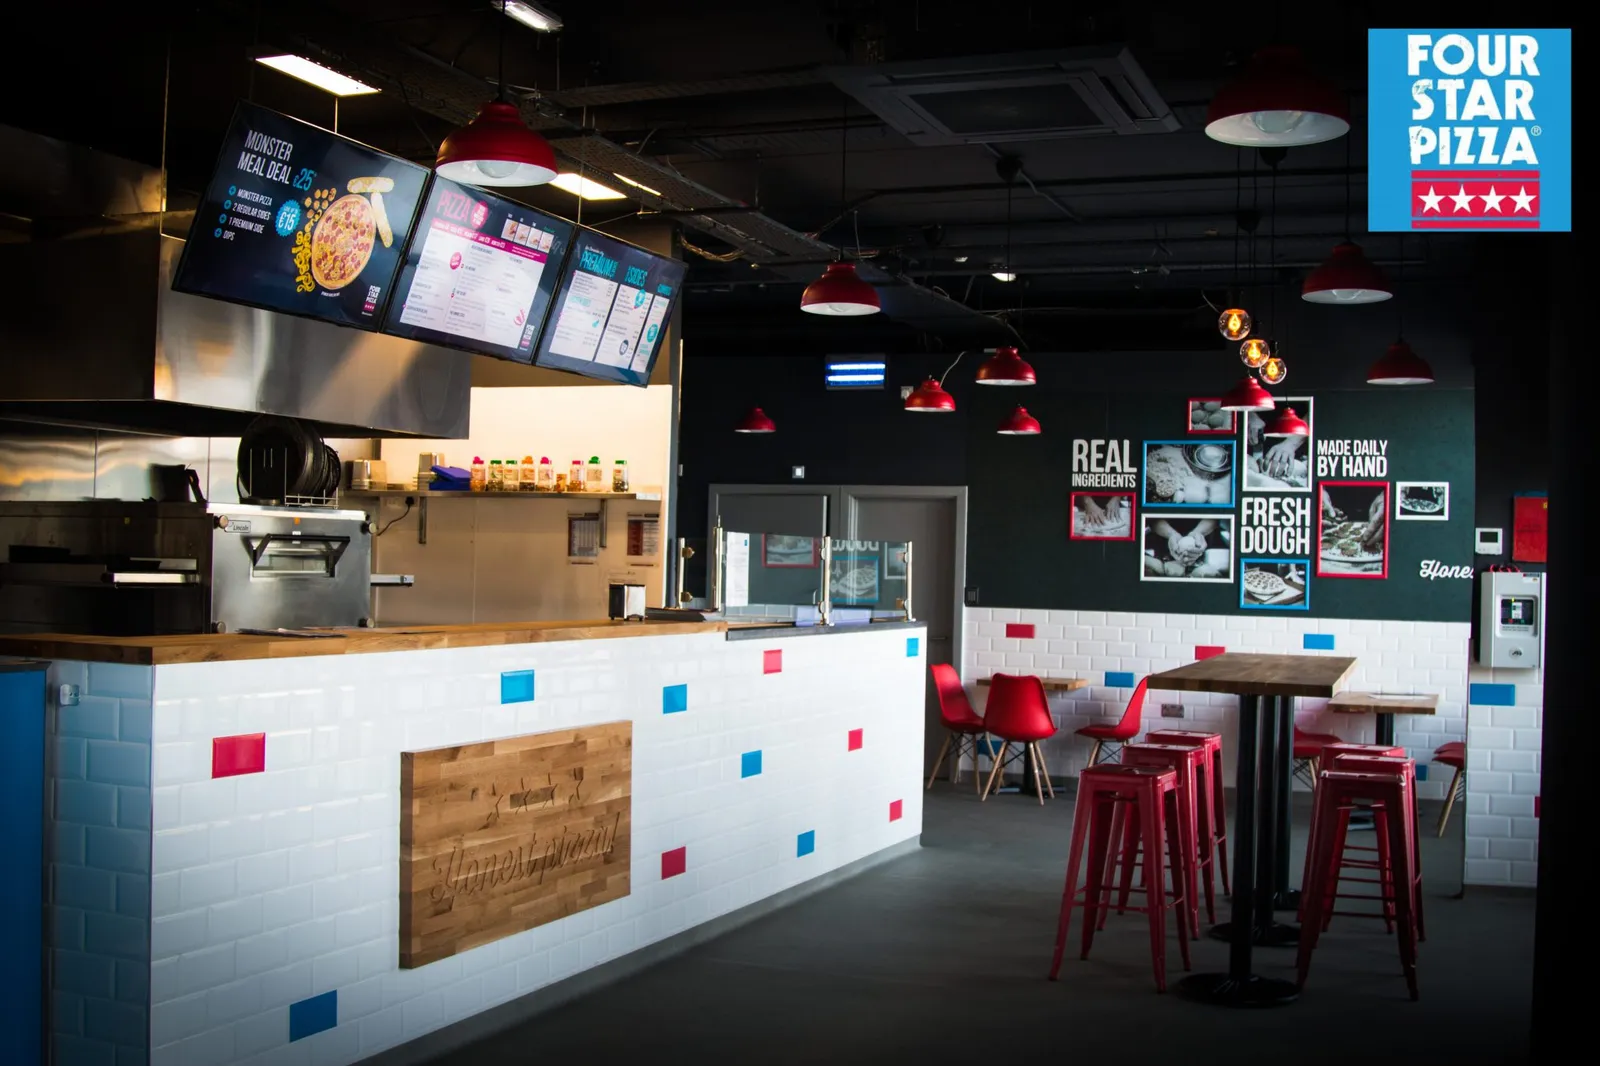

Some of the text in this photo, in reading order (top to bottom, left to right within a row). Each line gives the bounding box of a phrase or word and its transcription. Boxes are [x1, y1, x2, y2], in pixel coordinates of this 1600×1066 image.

[244, 130, 293, 161] MONSTER
[237, 151, 292, 184] MEAL DEAL
[237, 188, 273, 206] MONSTER PIZZA
[436, 189, 472, 222] PIZZA
[232, 202, 238, 212] 2
[236, 203, 258, 217] REGULAR
[257, 209, 271, 221] SIDES
[278, 211, 296, 231] €15
[222, 230, 235, 241] DIPS
[228, 216, 265, 234] 1 PREMIUM SIDE
[579, 250, 614, 278] PREMIUM
[1072, 439, 1138, 473] REAL
[1317, 439, 1388, 456] MADE DAILY
[1317, 456, 1388, 477] BY HAND
[1072, 473, 1137, 488] INGREDIENTS
[1241, 497, 1311, 526] FRESH
[1240, 526, 1311, 555] DOUGH
